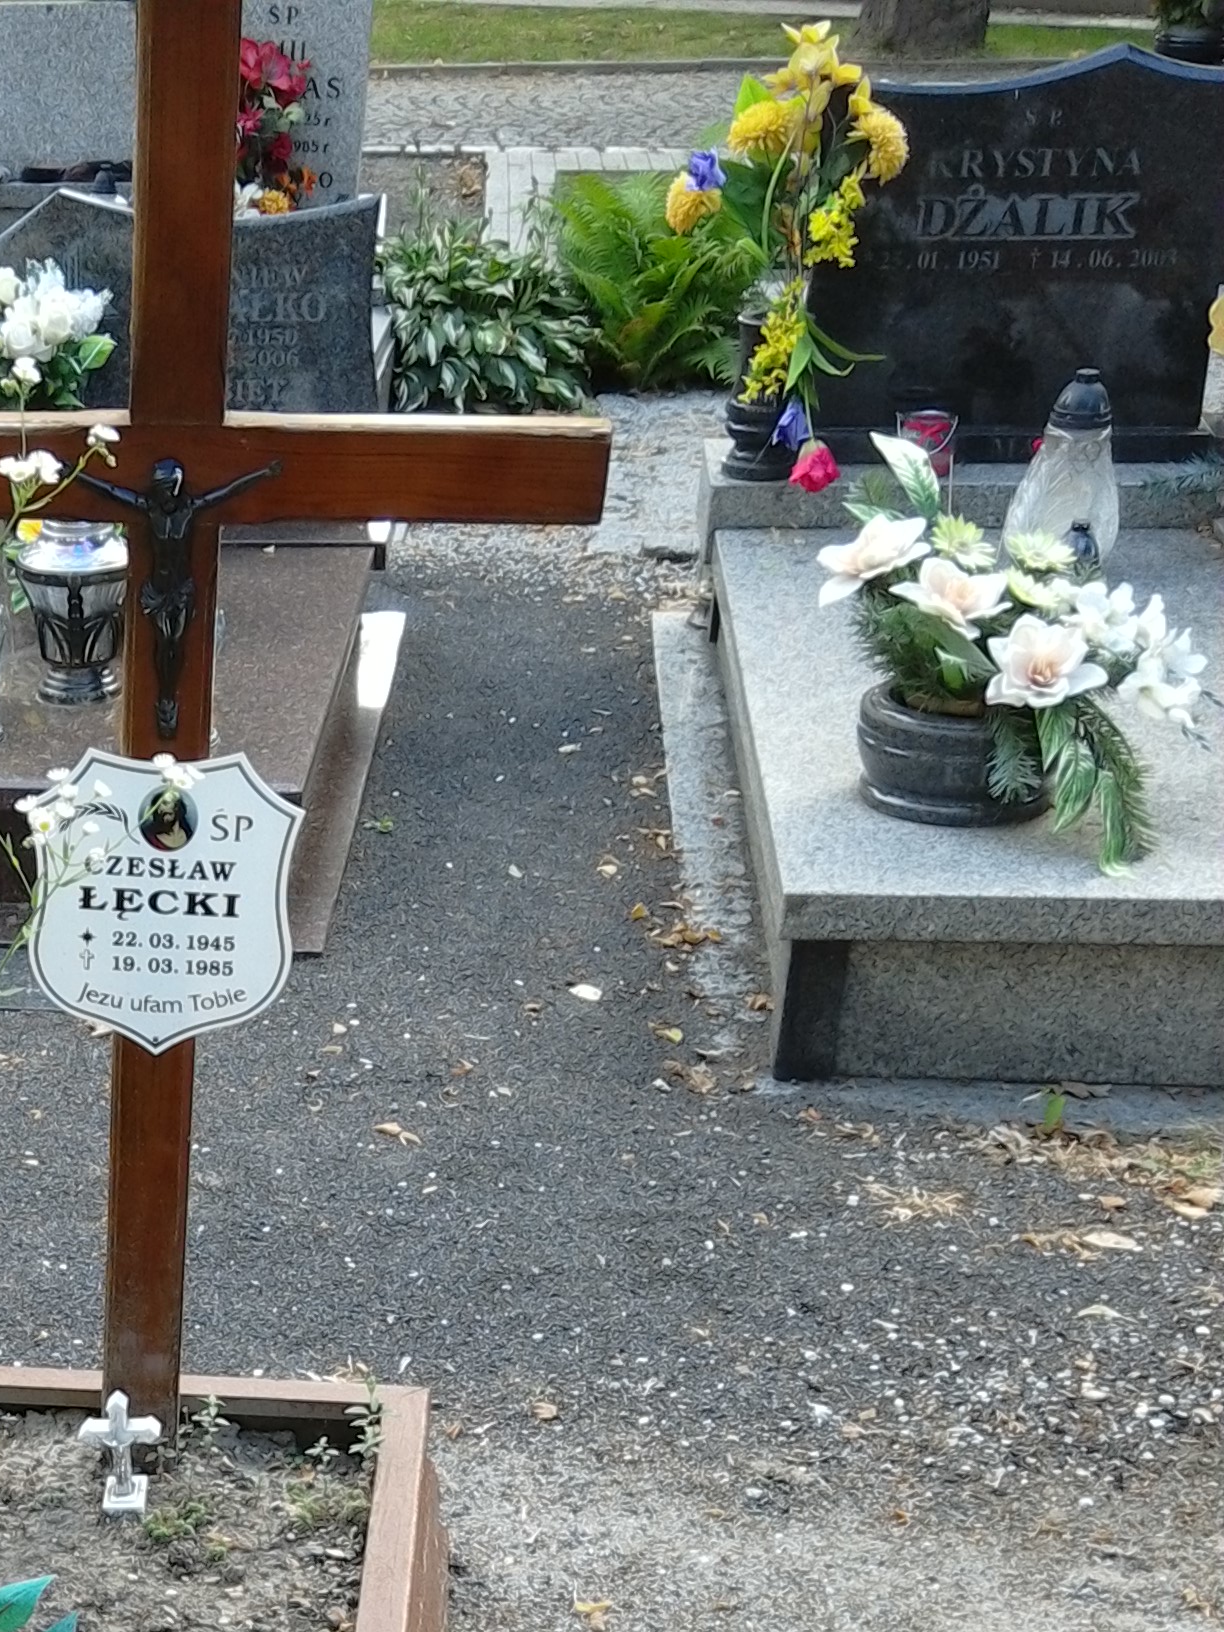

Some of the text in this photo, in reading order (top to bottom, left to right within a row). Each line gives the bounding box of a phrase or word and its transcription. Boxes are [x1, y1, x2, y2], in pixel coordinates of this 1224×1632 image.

[928, 147, 1143, 178] KRYSTYNA
[915, 183, 1141, 241] DŻALIK
[210, 808, 254, 843] ŚP
[84, 854, 237, 882] CZESŁAW
[78, 885, 241, 921] ŁĘCKI
[76, 982, 249, 1014] Jezu ufam Tobie
